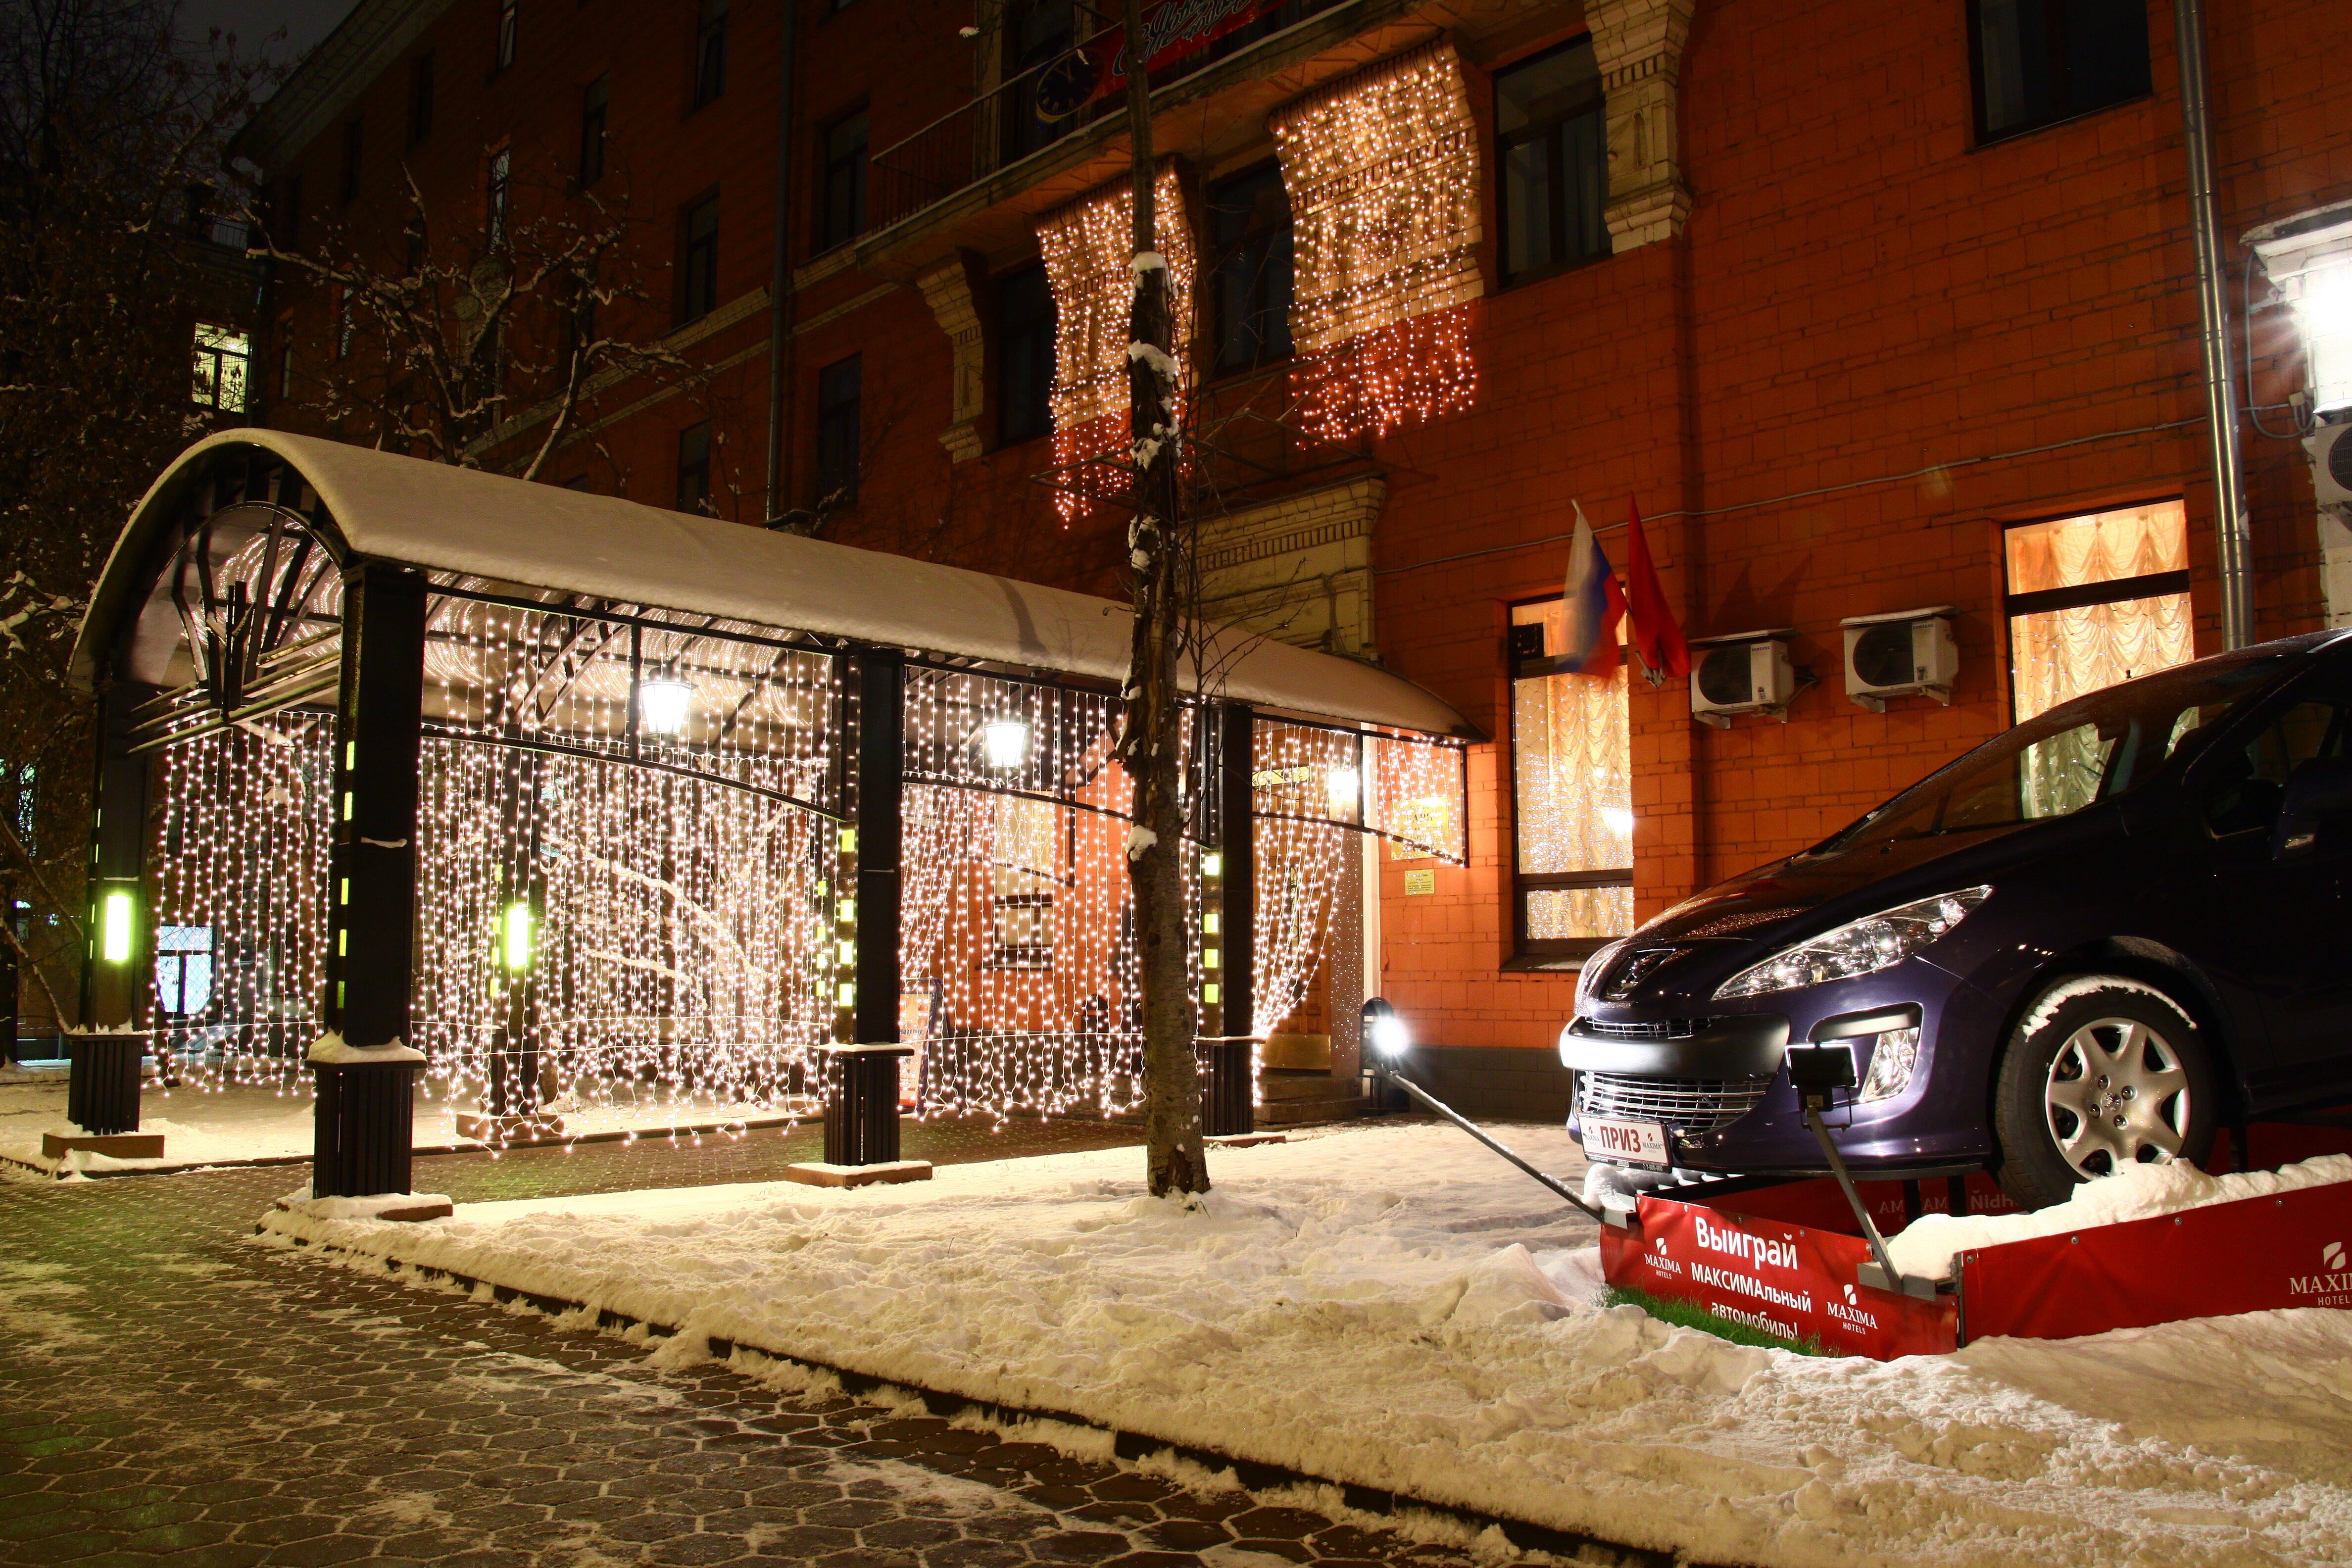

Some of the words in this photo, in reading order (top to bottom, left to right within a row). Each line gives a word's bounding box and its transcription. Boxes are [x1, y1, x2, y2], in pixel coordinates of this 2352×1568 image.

[1600, 1126, 1641, 1153] ПРИЗ
[1695, 1216, 1798, 1270] Выиграй
[1644, 1253, 1682, 1274] MAXIMA
[1656, 1270, 1672, 1279] HOTELS
[2289, 1273, 2352, 1294] MAXI
[2317, 1294, 2352, 1306] HOTEL
[1827, 1301, 1878, 1329] MAXIMA
[1843, 1322, 1866, 1335] HOTELS
